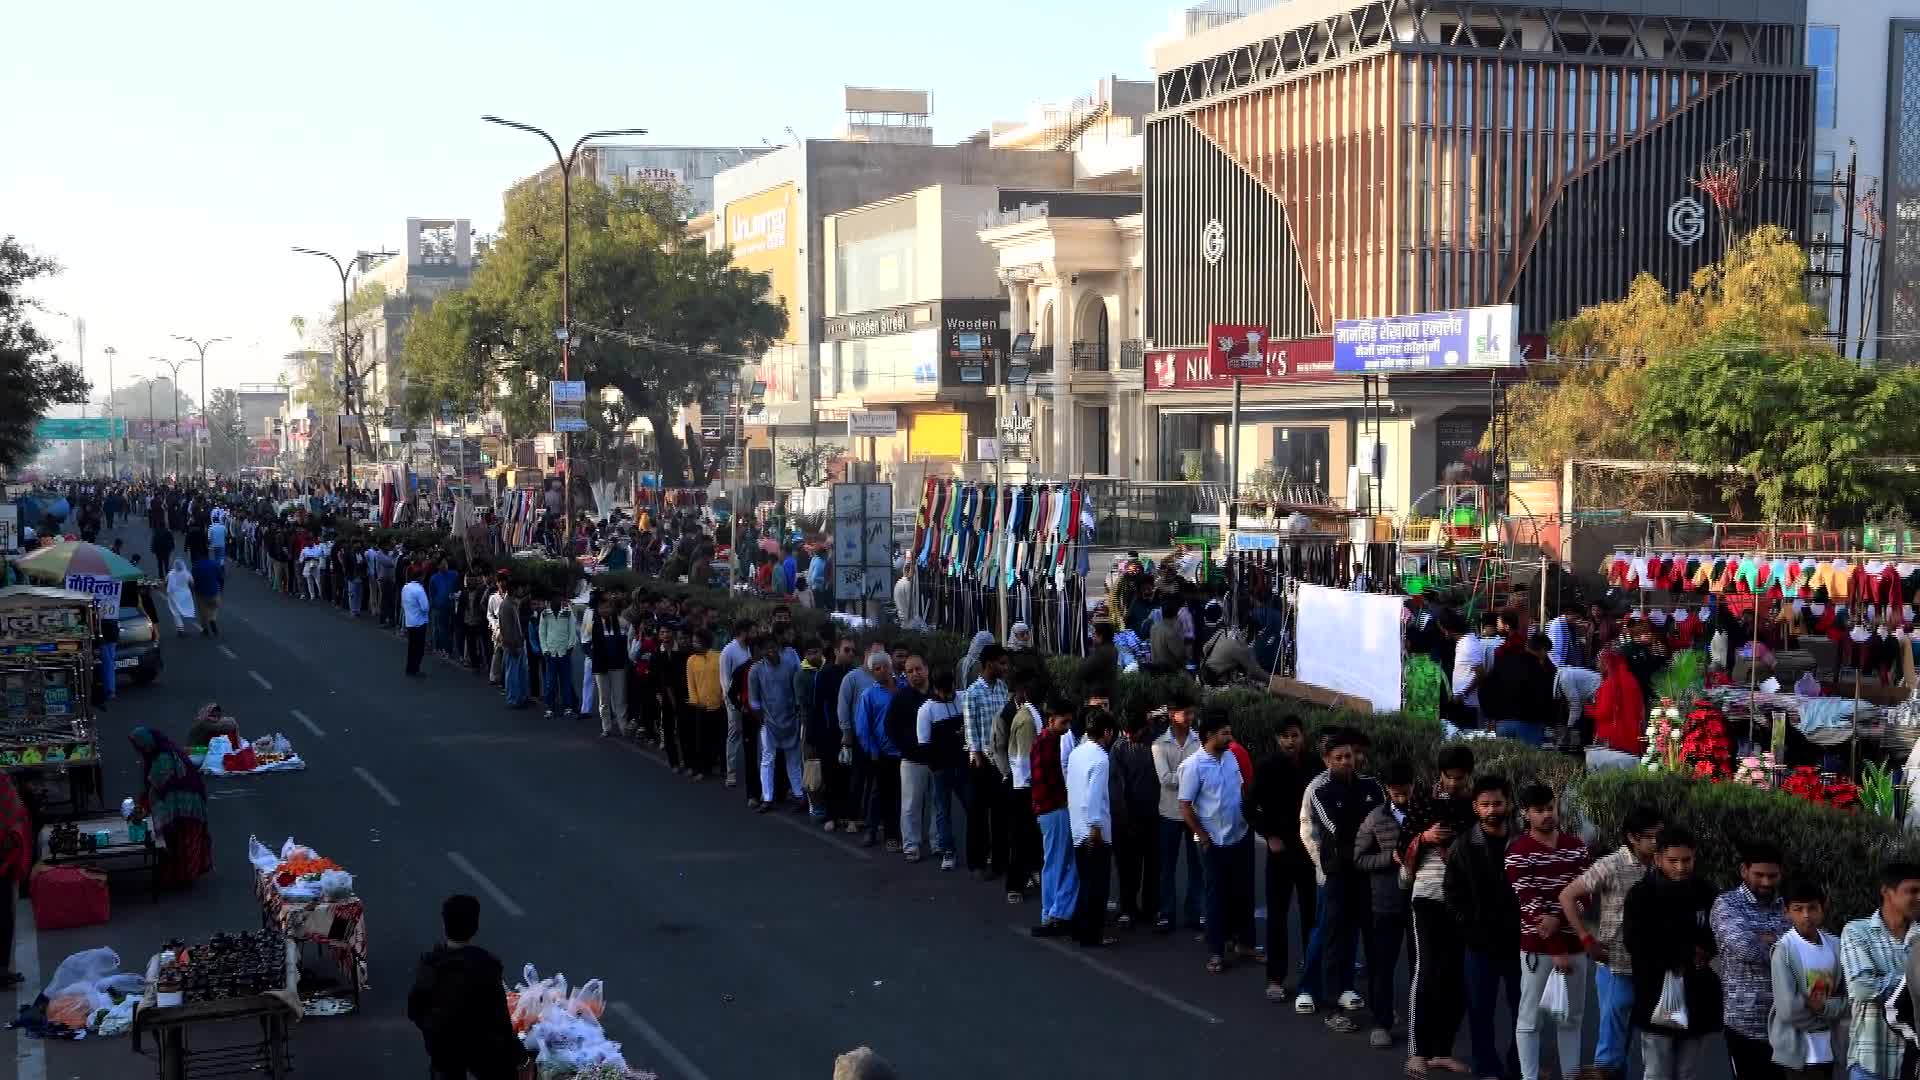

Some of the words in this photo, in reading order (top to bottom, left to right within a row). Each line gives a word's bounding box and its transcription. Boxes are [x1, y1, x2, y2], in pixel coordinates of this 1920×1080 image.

[849, 318, 880, 337] Wooden
[880, 313, 907, 333] Street
[946, 317, 997, 330] Wooden
